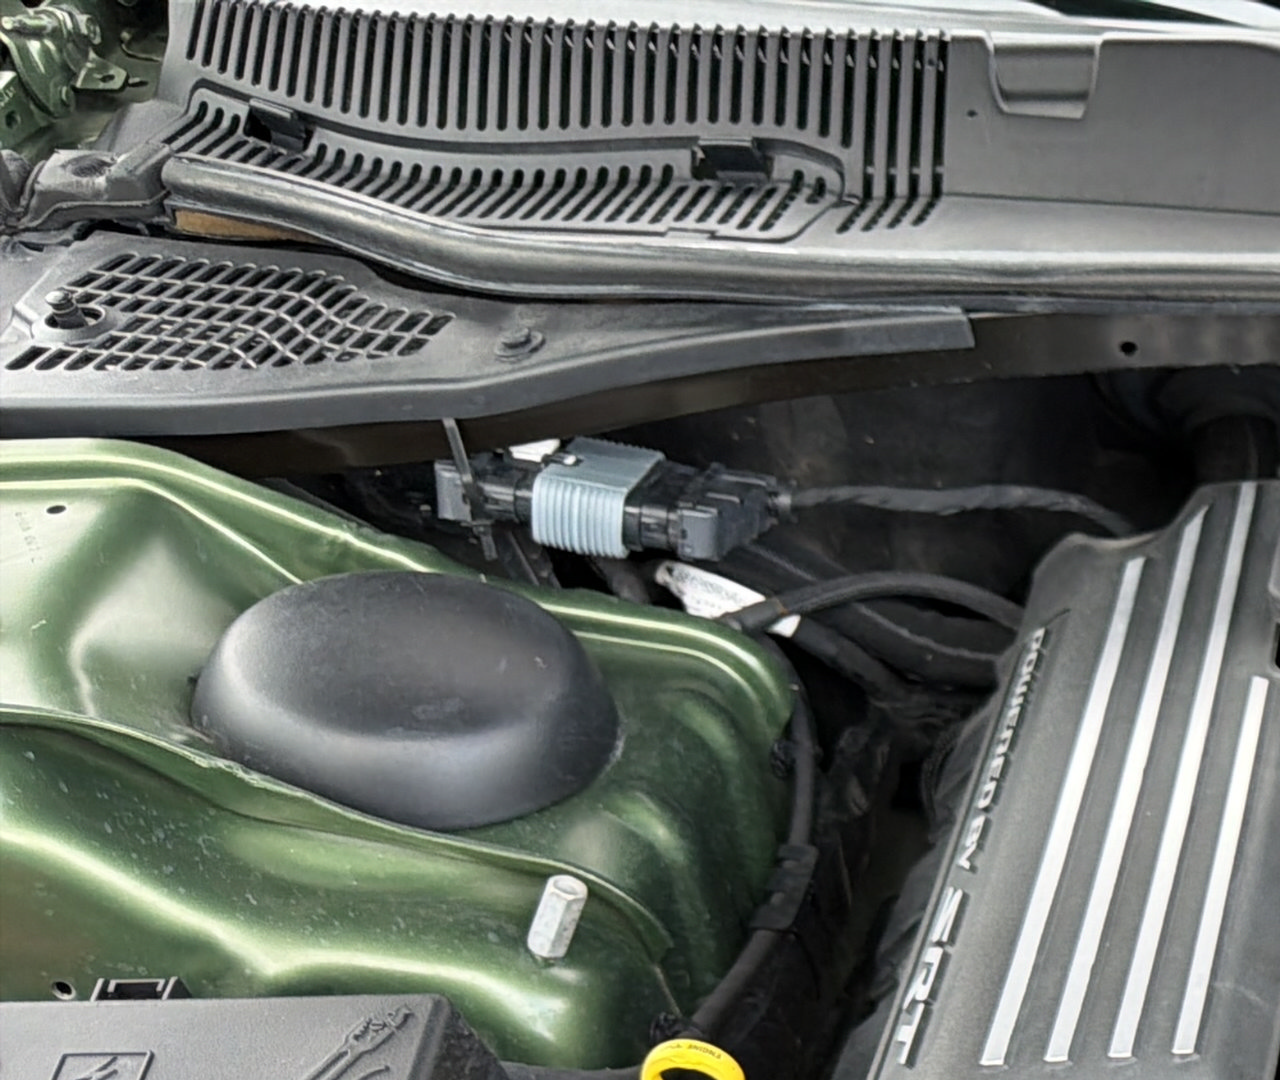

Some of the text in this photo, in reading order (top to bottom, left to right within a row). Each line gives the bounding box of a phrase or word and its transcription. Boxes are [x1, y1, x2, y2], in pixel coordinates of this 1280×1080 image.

[896, 627, 1046, 1065] POWERED BY SRT
